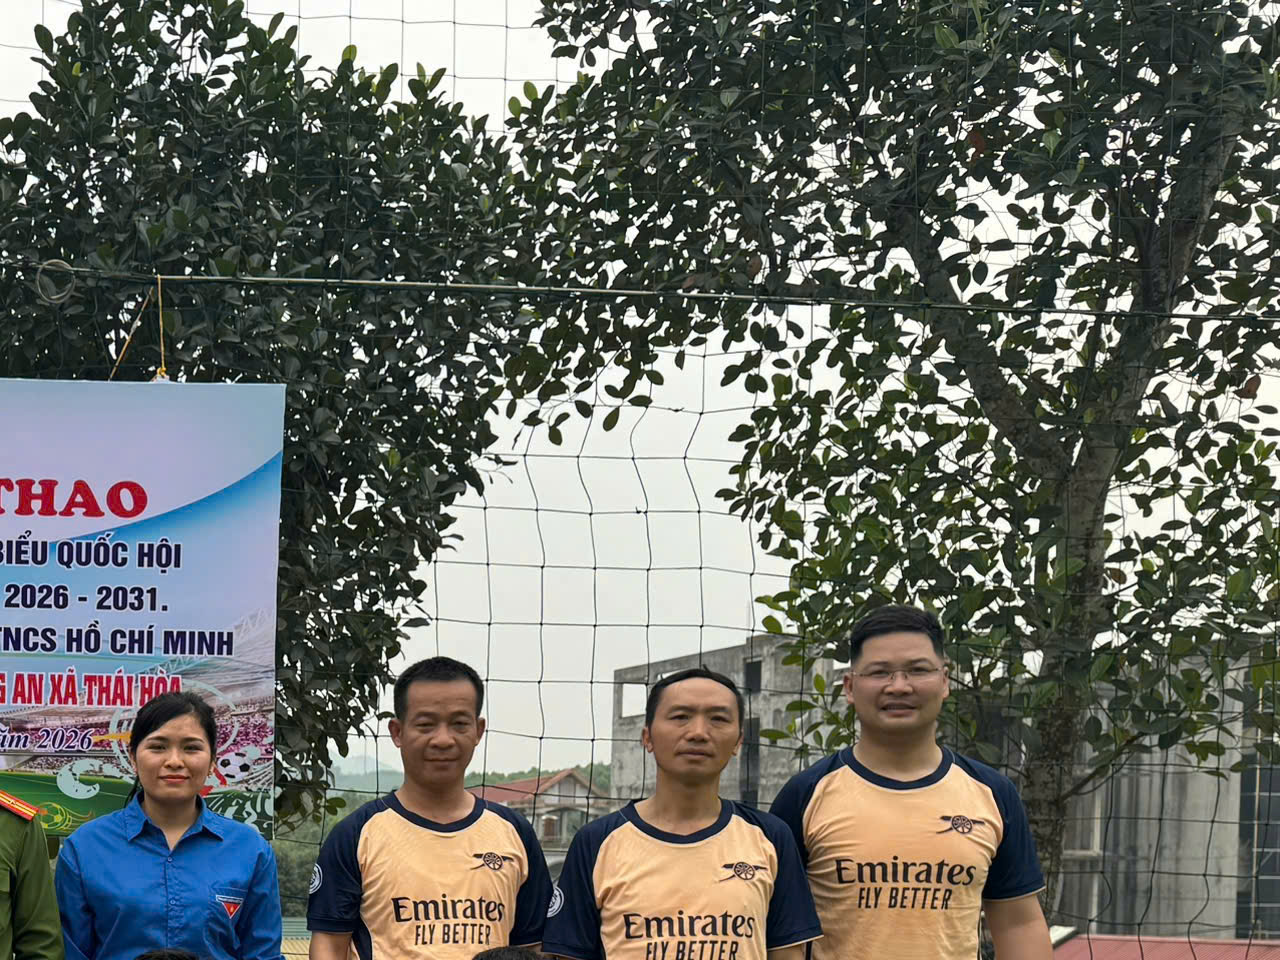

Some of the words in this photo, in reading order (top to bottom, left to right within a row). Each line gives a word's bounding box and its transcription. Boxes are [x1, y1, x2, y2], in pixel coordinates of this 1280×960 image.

[57, 530, 129, 569] QUỐC
[137, 537, 182, 574] HỘI
[5, 583, 69, 611] 2026
[96, 584, 167, 612] 2031.
[66, 616, 101, 654] HỒ
[110, 622, 154, 655] CHÍ
[164, 629, 234, 656] MINH
[12, 672, 43, 705] AN
[50, 668, 78, 706] XÃ
[84, 668, 134, 707] THÁI
[139, 669, 181, 706] HÒA
[37, 728, 94, 751] 2026
[836, 855, 977, 887] Emirates
[390, 893, 505, 923] Emirates
[857, 887, 883, 909] FLY
[887, 887, 953, 910] BETTER
[415, 924, 437, 946] FLY
[442, 923, 492, 945] BETTER
[622, 910, 756, 940] Emirates
